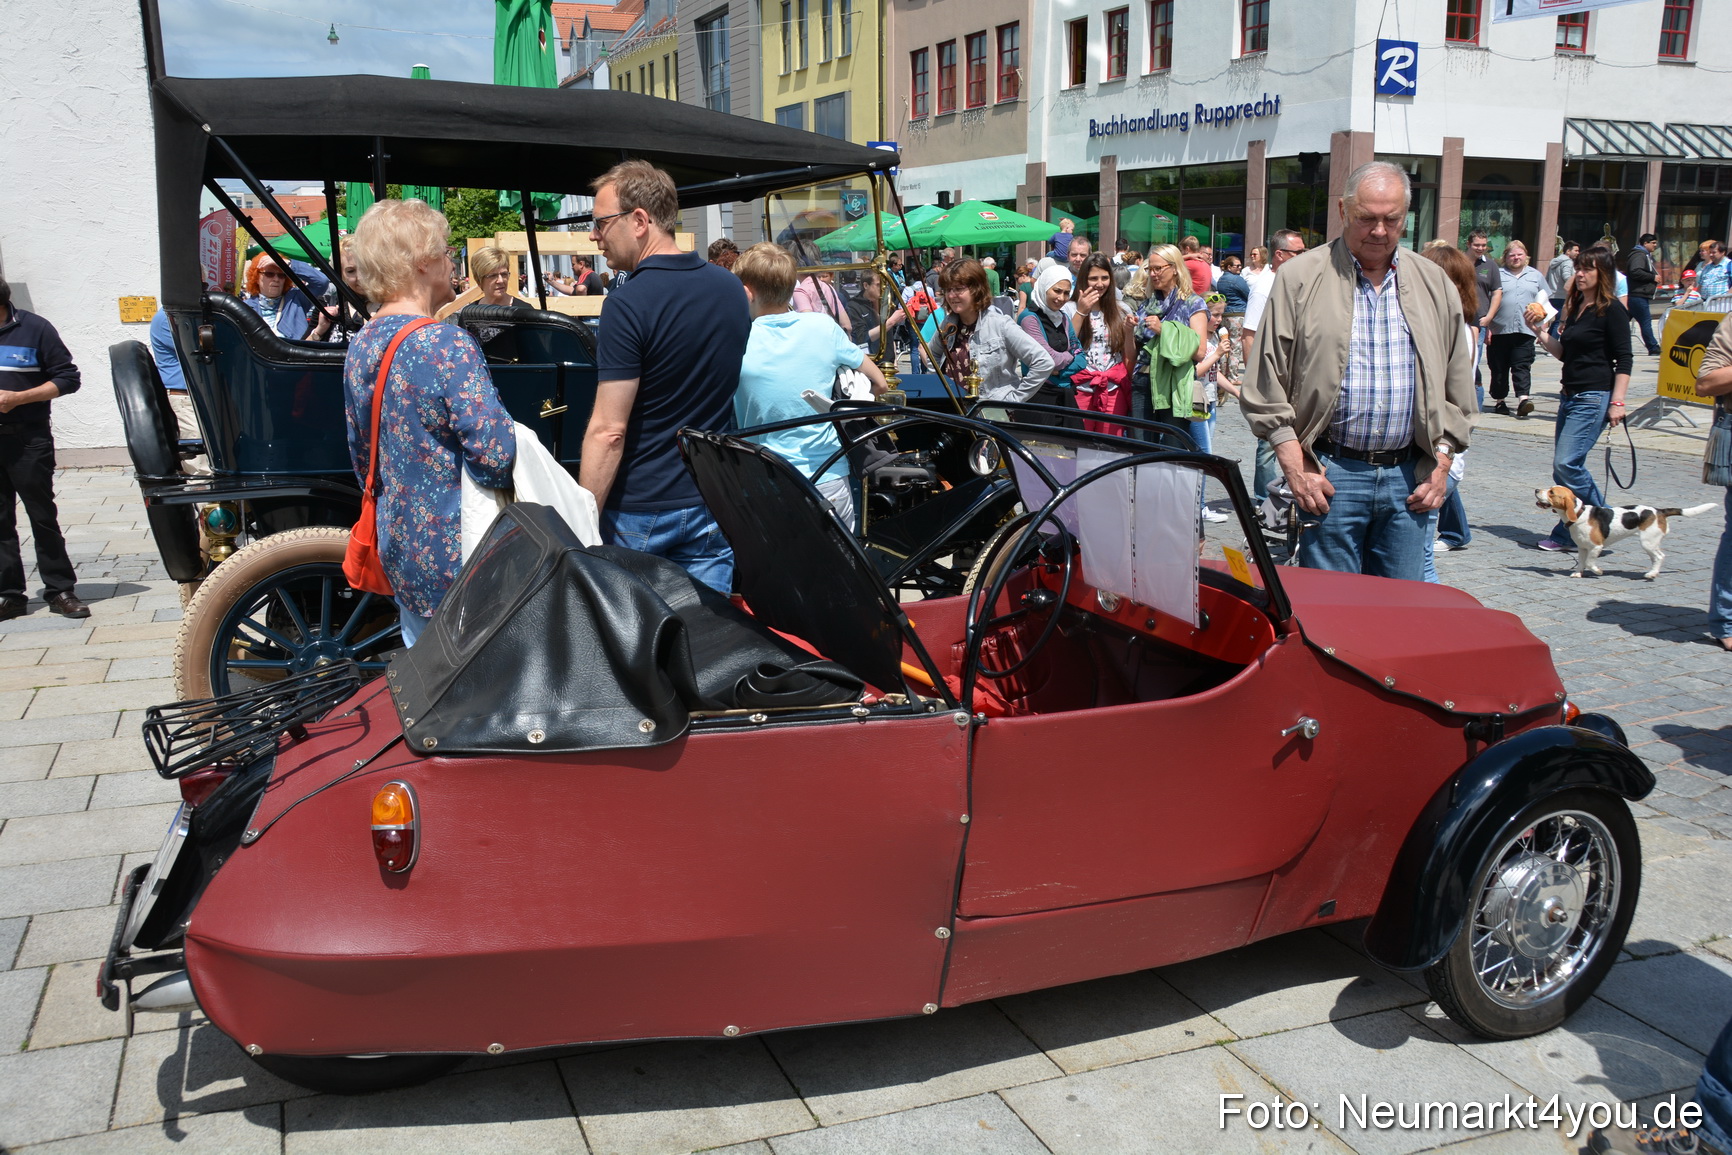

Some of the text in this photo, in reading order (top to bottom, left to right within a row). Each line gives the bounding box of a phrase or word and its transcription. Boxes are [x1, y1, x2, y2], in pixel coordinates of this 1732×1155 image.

[1088, 92, 1281, 138] Buchhandlung Rupprecht
[207, 239, 217, 282] Dietz
